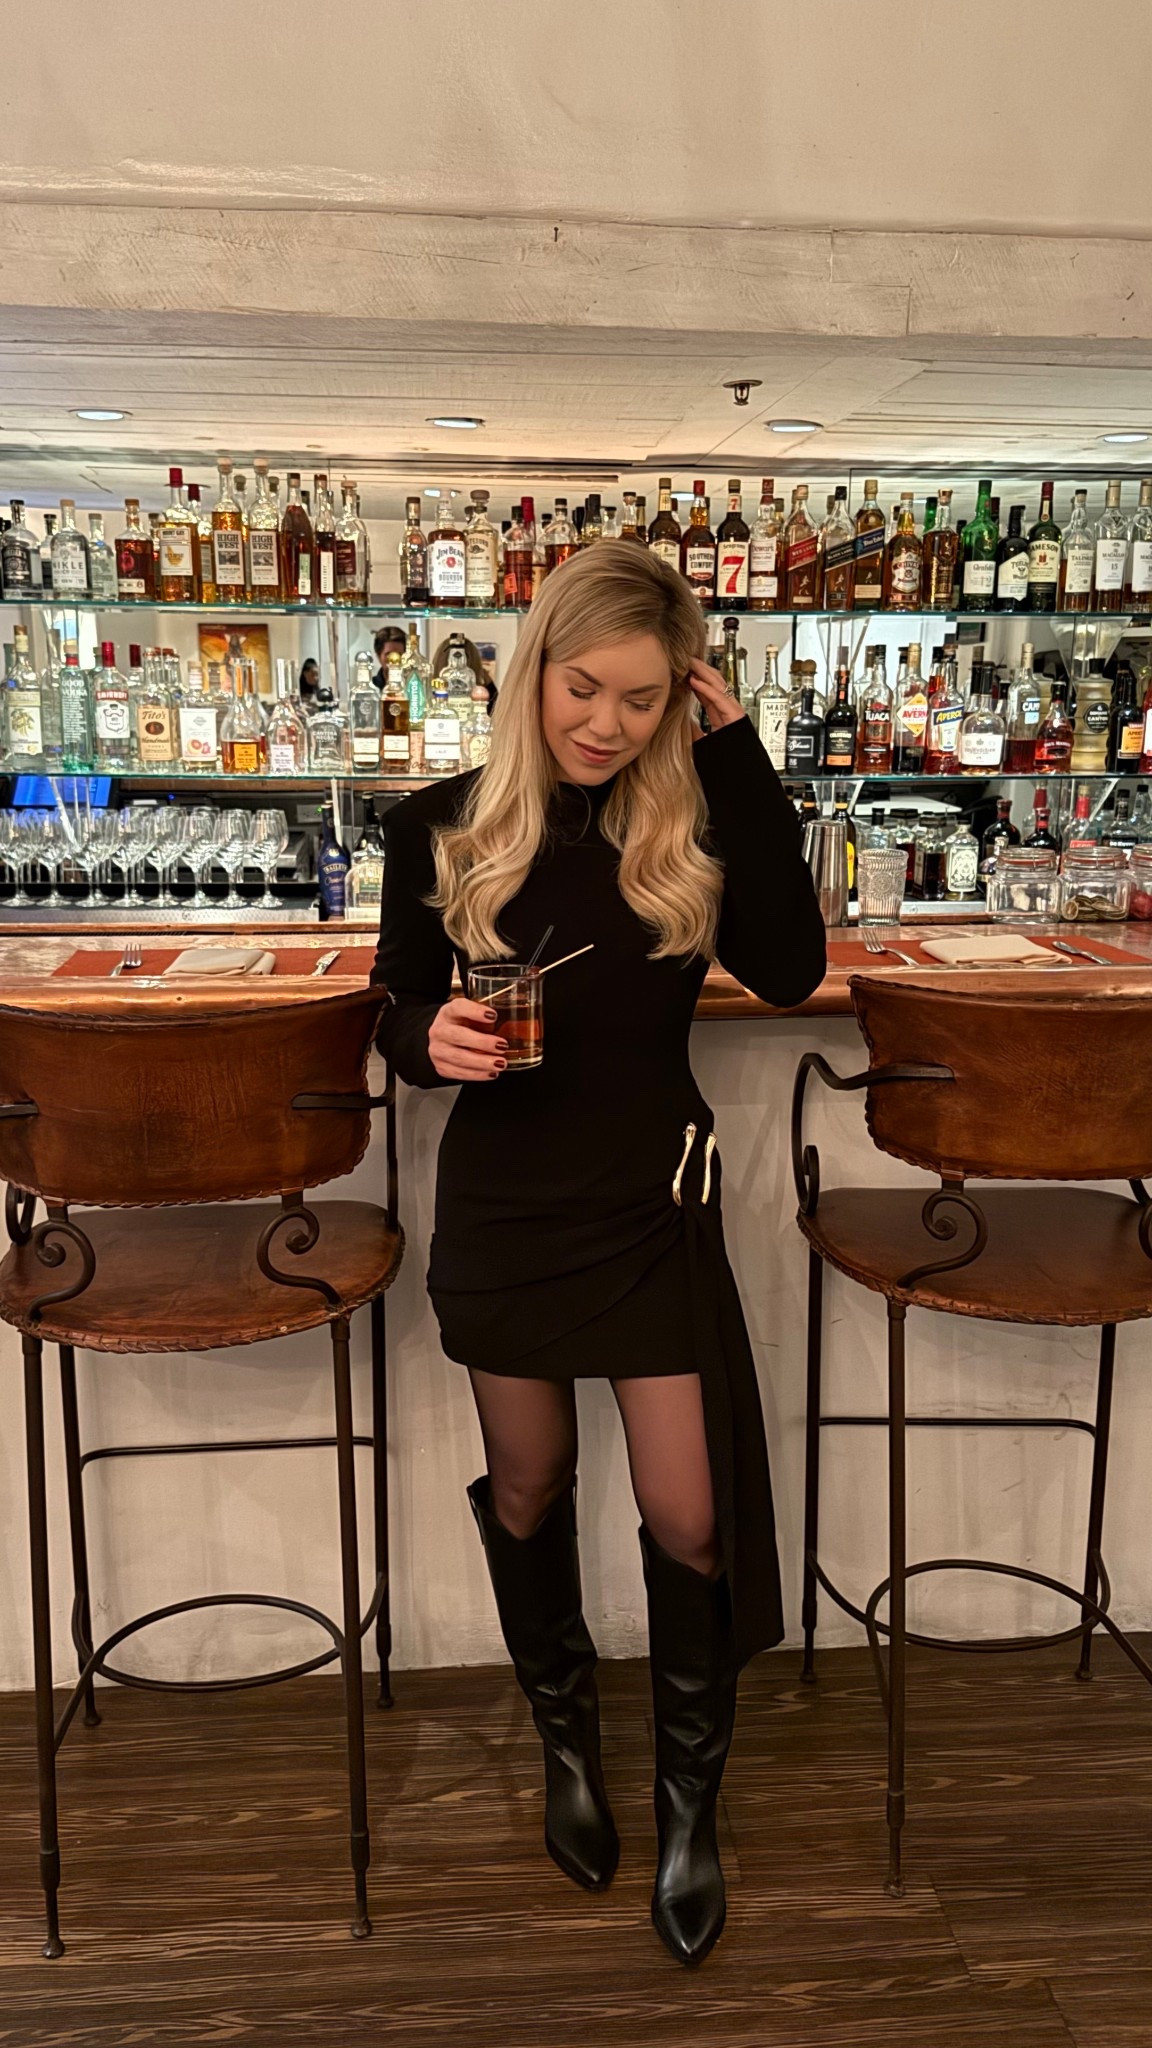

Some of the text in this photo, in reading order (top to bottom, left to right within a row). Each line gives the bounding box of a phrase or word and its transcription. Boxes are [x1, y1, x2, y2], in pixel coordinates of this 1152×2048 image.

[731, 499, 738, 510] 7
[217, 534, 239, 542] HIGH
[251, 535, 273, 543] HIGH
[436, 548, 449, 559] JIM
[721, 556, 746, 594] 7
[142, 710, 166, 720] Tito's
[865, 710, 890, 720] TUACA
